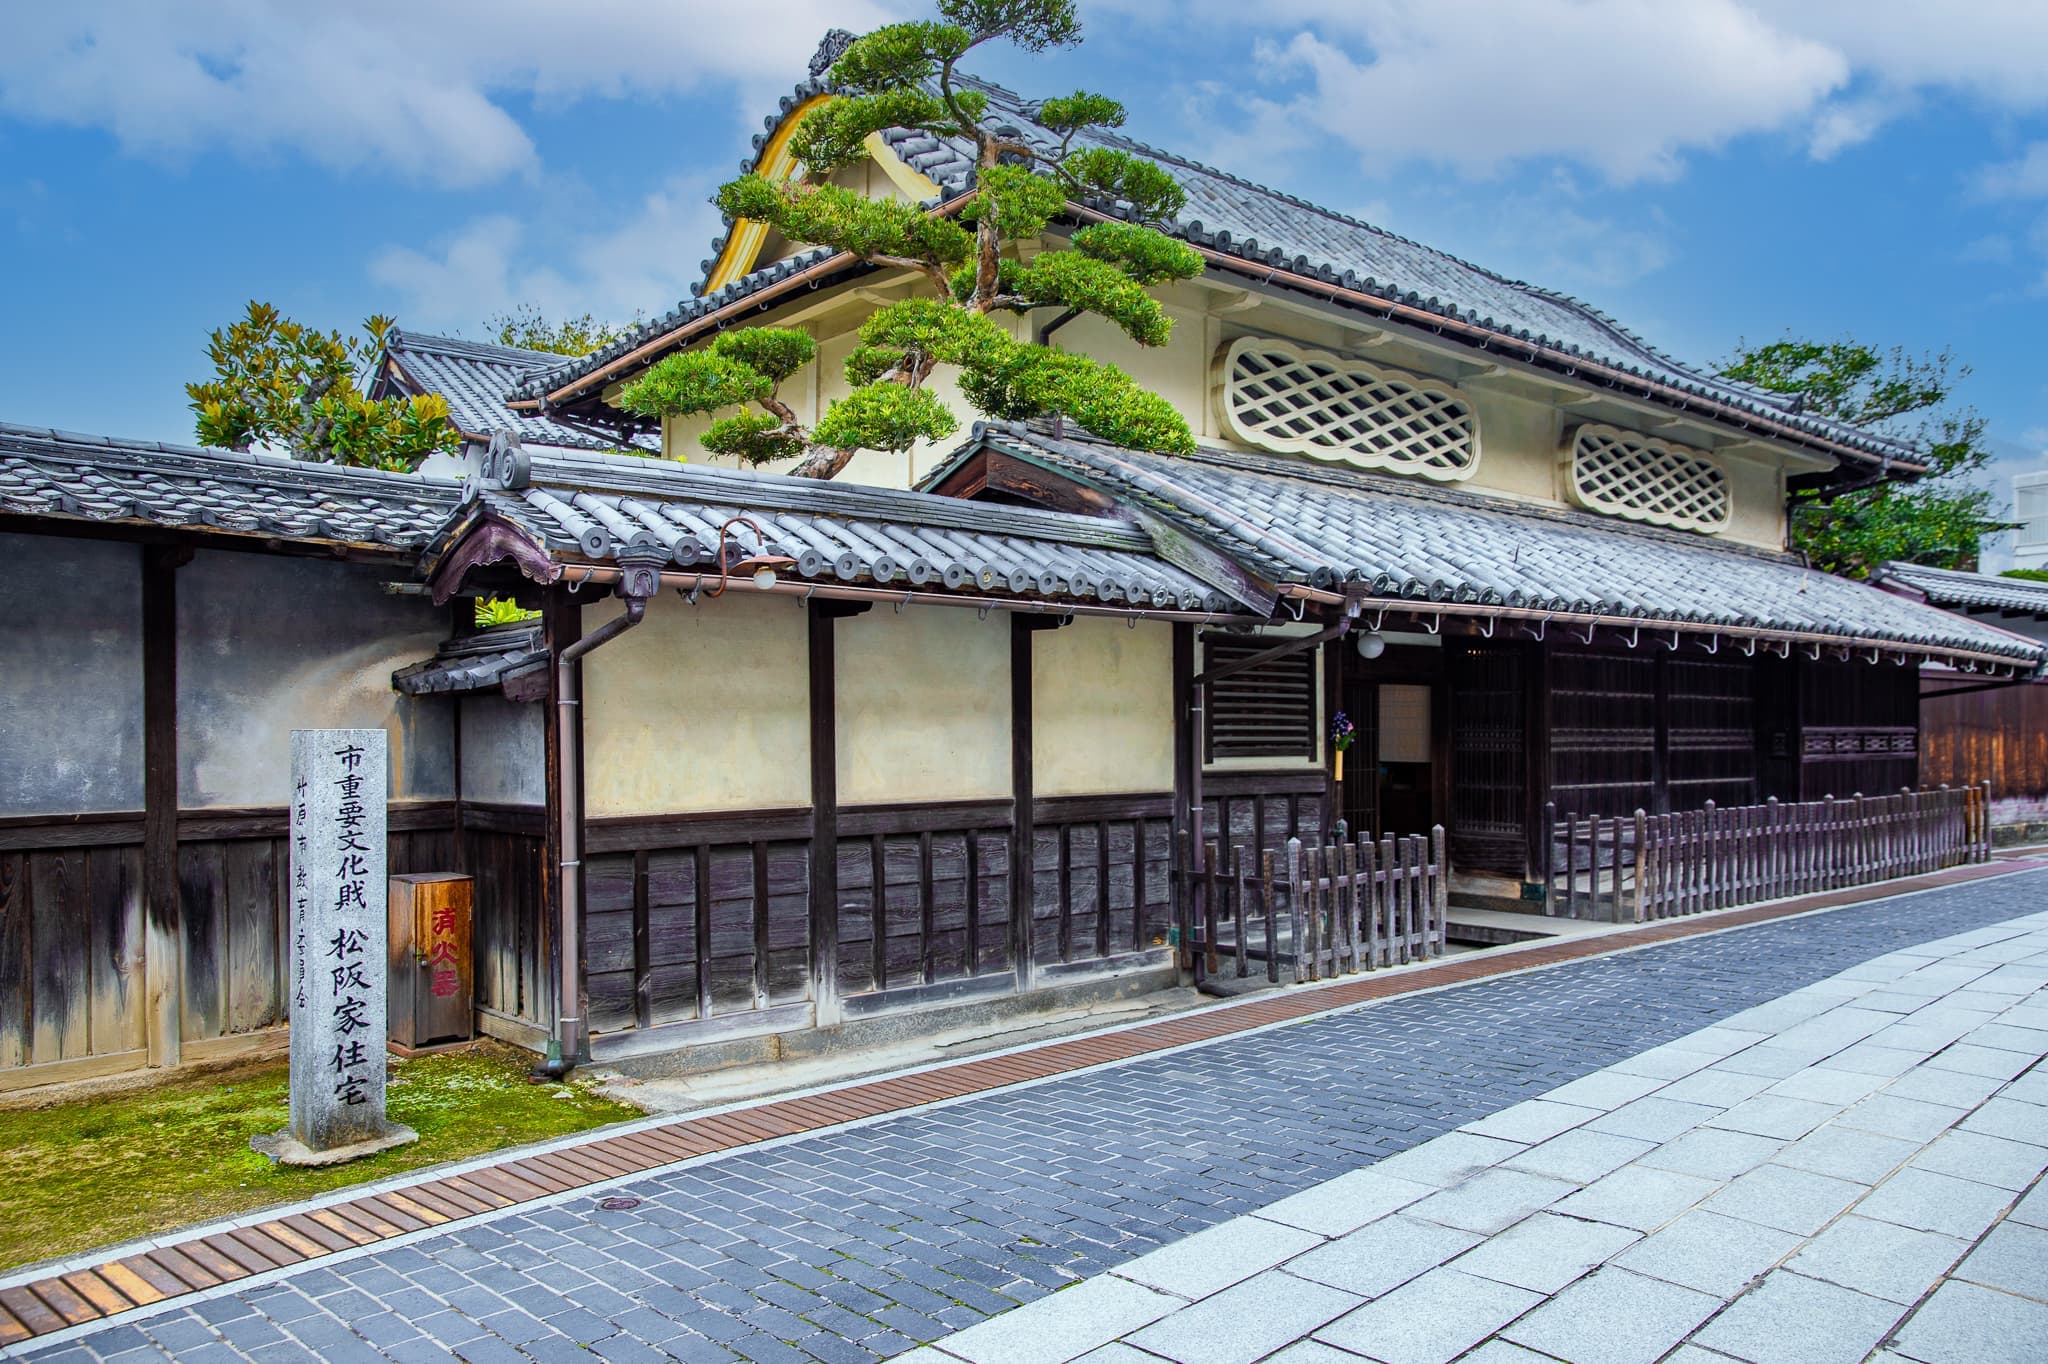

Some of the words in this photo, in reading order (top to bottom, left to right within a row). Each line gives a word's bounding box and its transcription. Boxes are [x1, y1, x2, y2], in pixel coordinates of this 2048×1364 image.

[325, 927, 371, 1106] 松阪家住宅
[431, 907, 460, 999] 消火器
